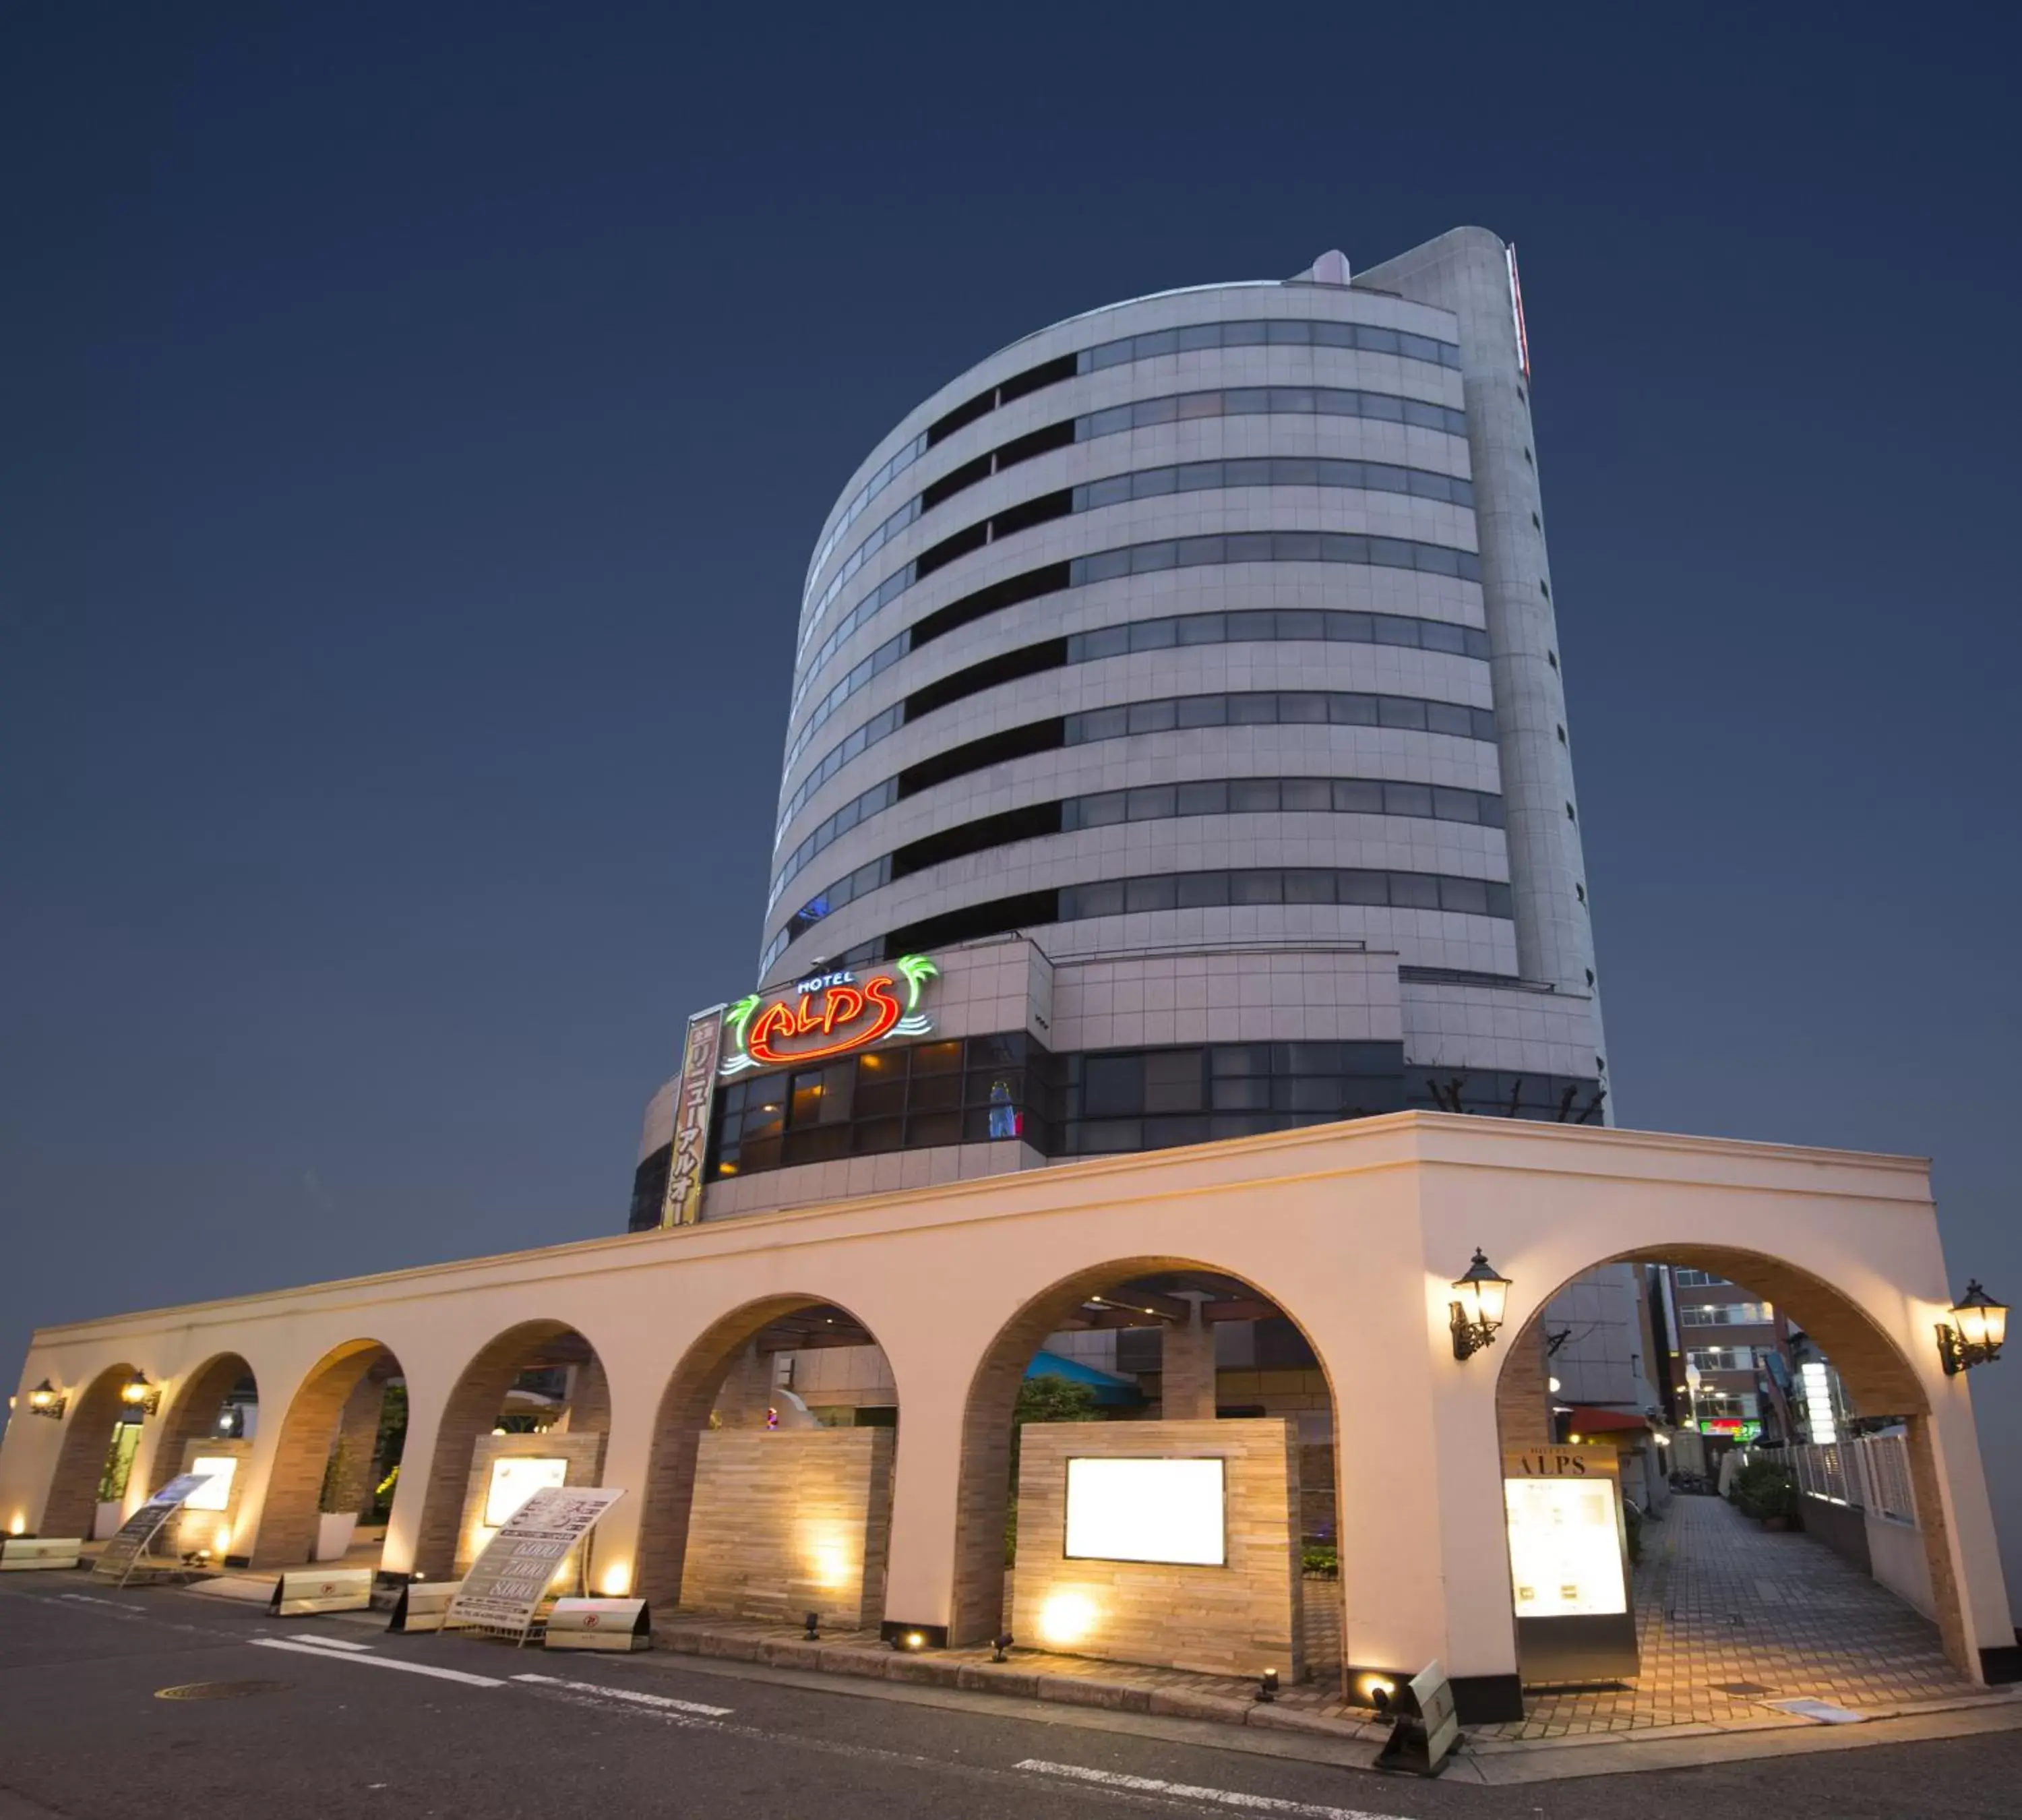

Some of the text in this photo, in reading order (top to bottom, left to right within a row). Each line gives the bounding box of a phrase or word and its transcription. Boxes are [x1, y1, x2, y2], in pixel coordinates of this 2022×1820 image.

[797, 971, 854, 994] HOTEL
[749, 975, 899, 1062] ALPS
[1518, 1455, 1586, 1475] ALPS
